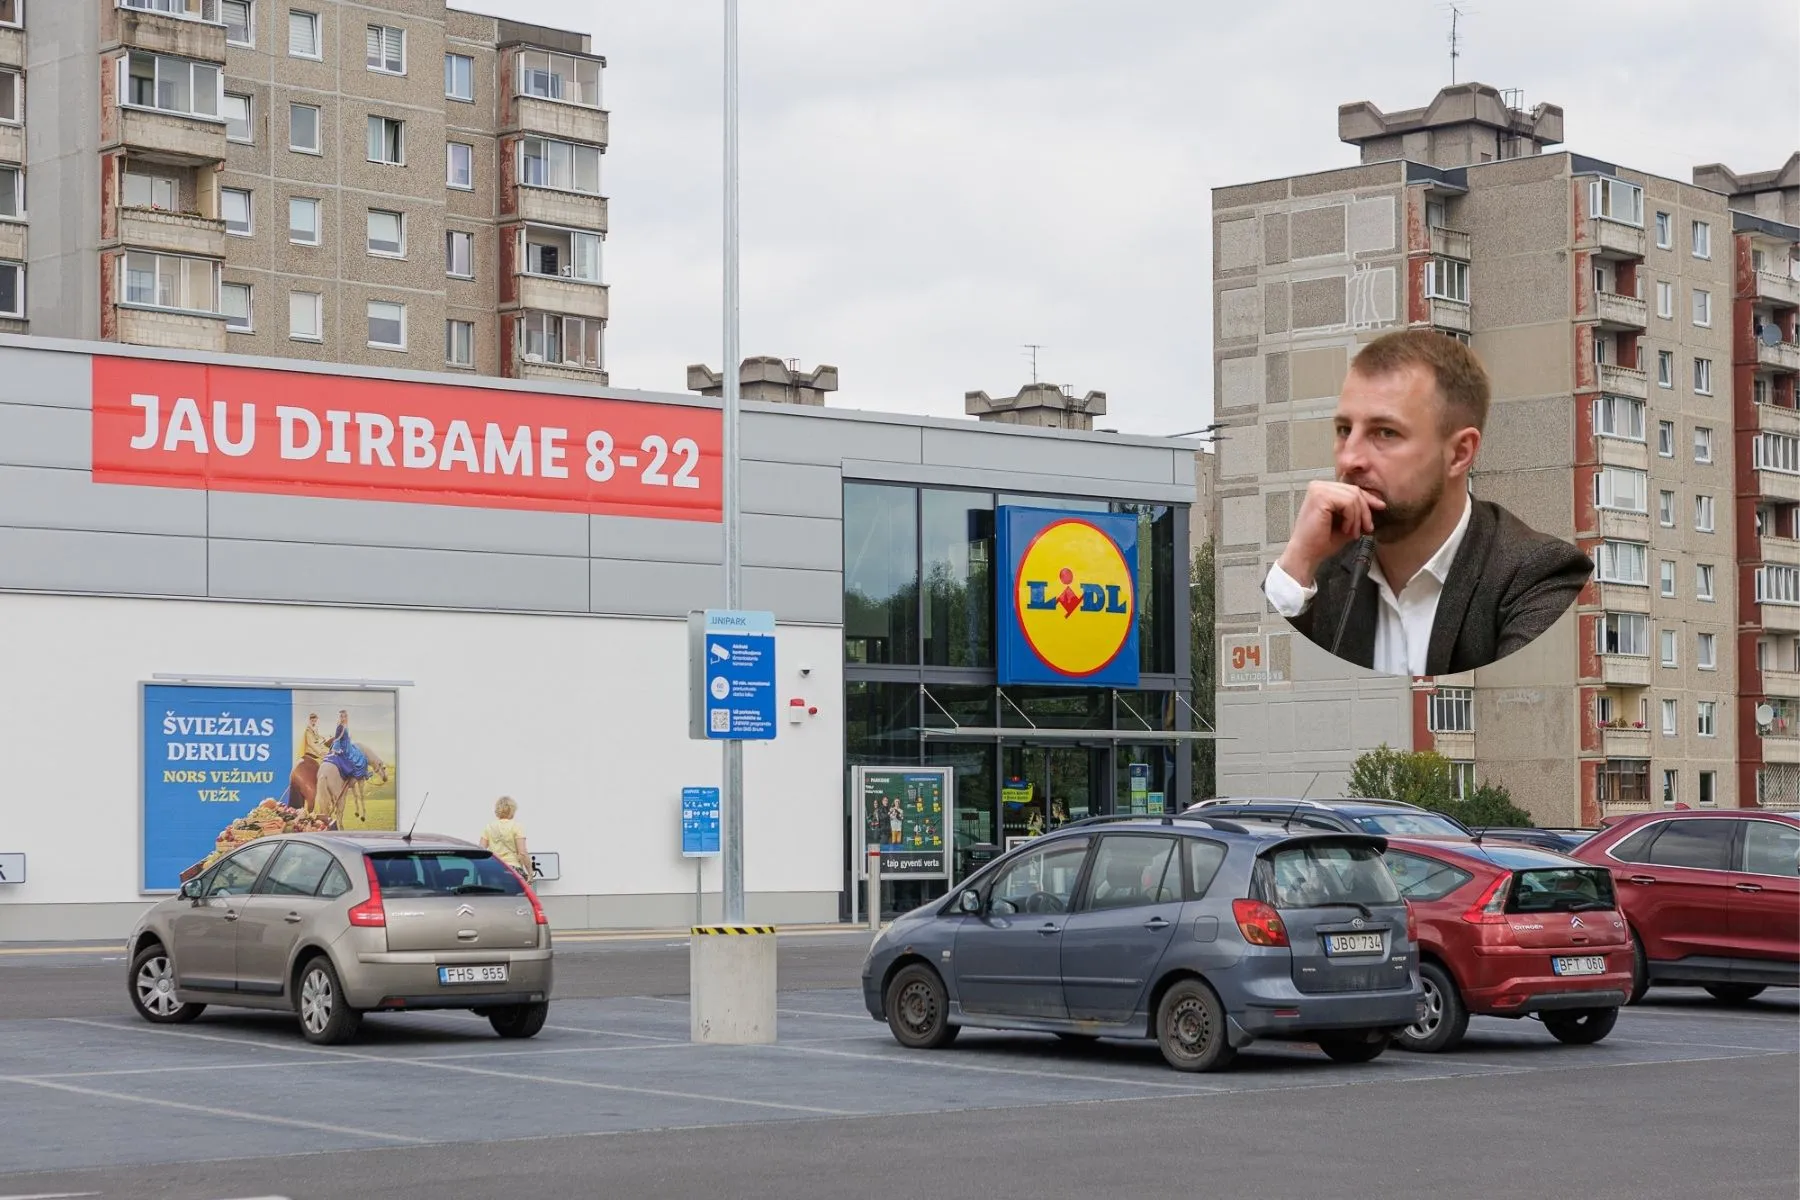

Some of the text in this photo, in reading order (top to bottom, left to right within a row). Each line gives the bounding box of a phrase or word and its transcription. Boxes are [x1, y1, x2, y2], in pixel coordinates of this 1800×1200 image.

[130, 393, 700, 489] JAU DIRBAME 8-22
[711, 616, 747, 626] UNIPARK
[1232, 645, 1261, 669] 34
[163, 710, 274, 737] ŠVIEŽIAS
[167, 742, 270, 762] DERLIUS
[163, 768, 274, 784] NORS VEŽIMU
[197, 785, 240, 802] VEŽK
[886, 858, 899, 869] taip
[900, 858, 923, 869] gyventi
[923, 858, 940, 867] verta
[1333, 935, 1381, 951] JBO 734
[1559, 957, 1604, 971] BFT 060
[447, 967, 504, 981] FHS 955
